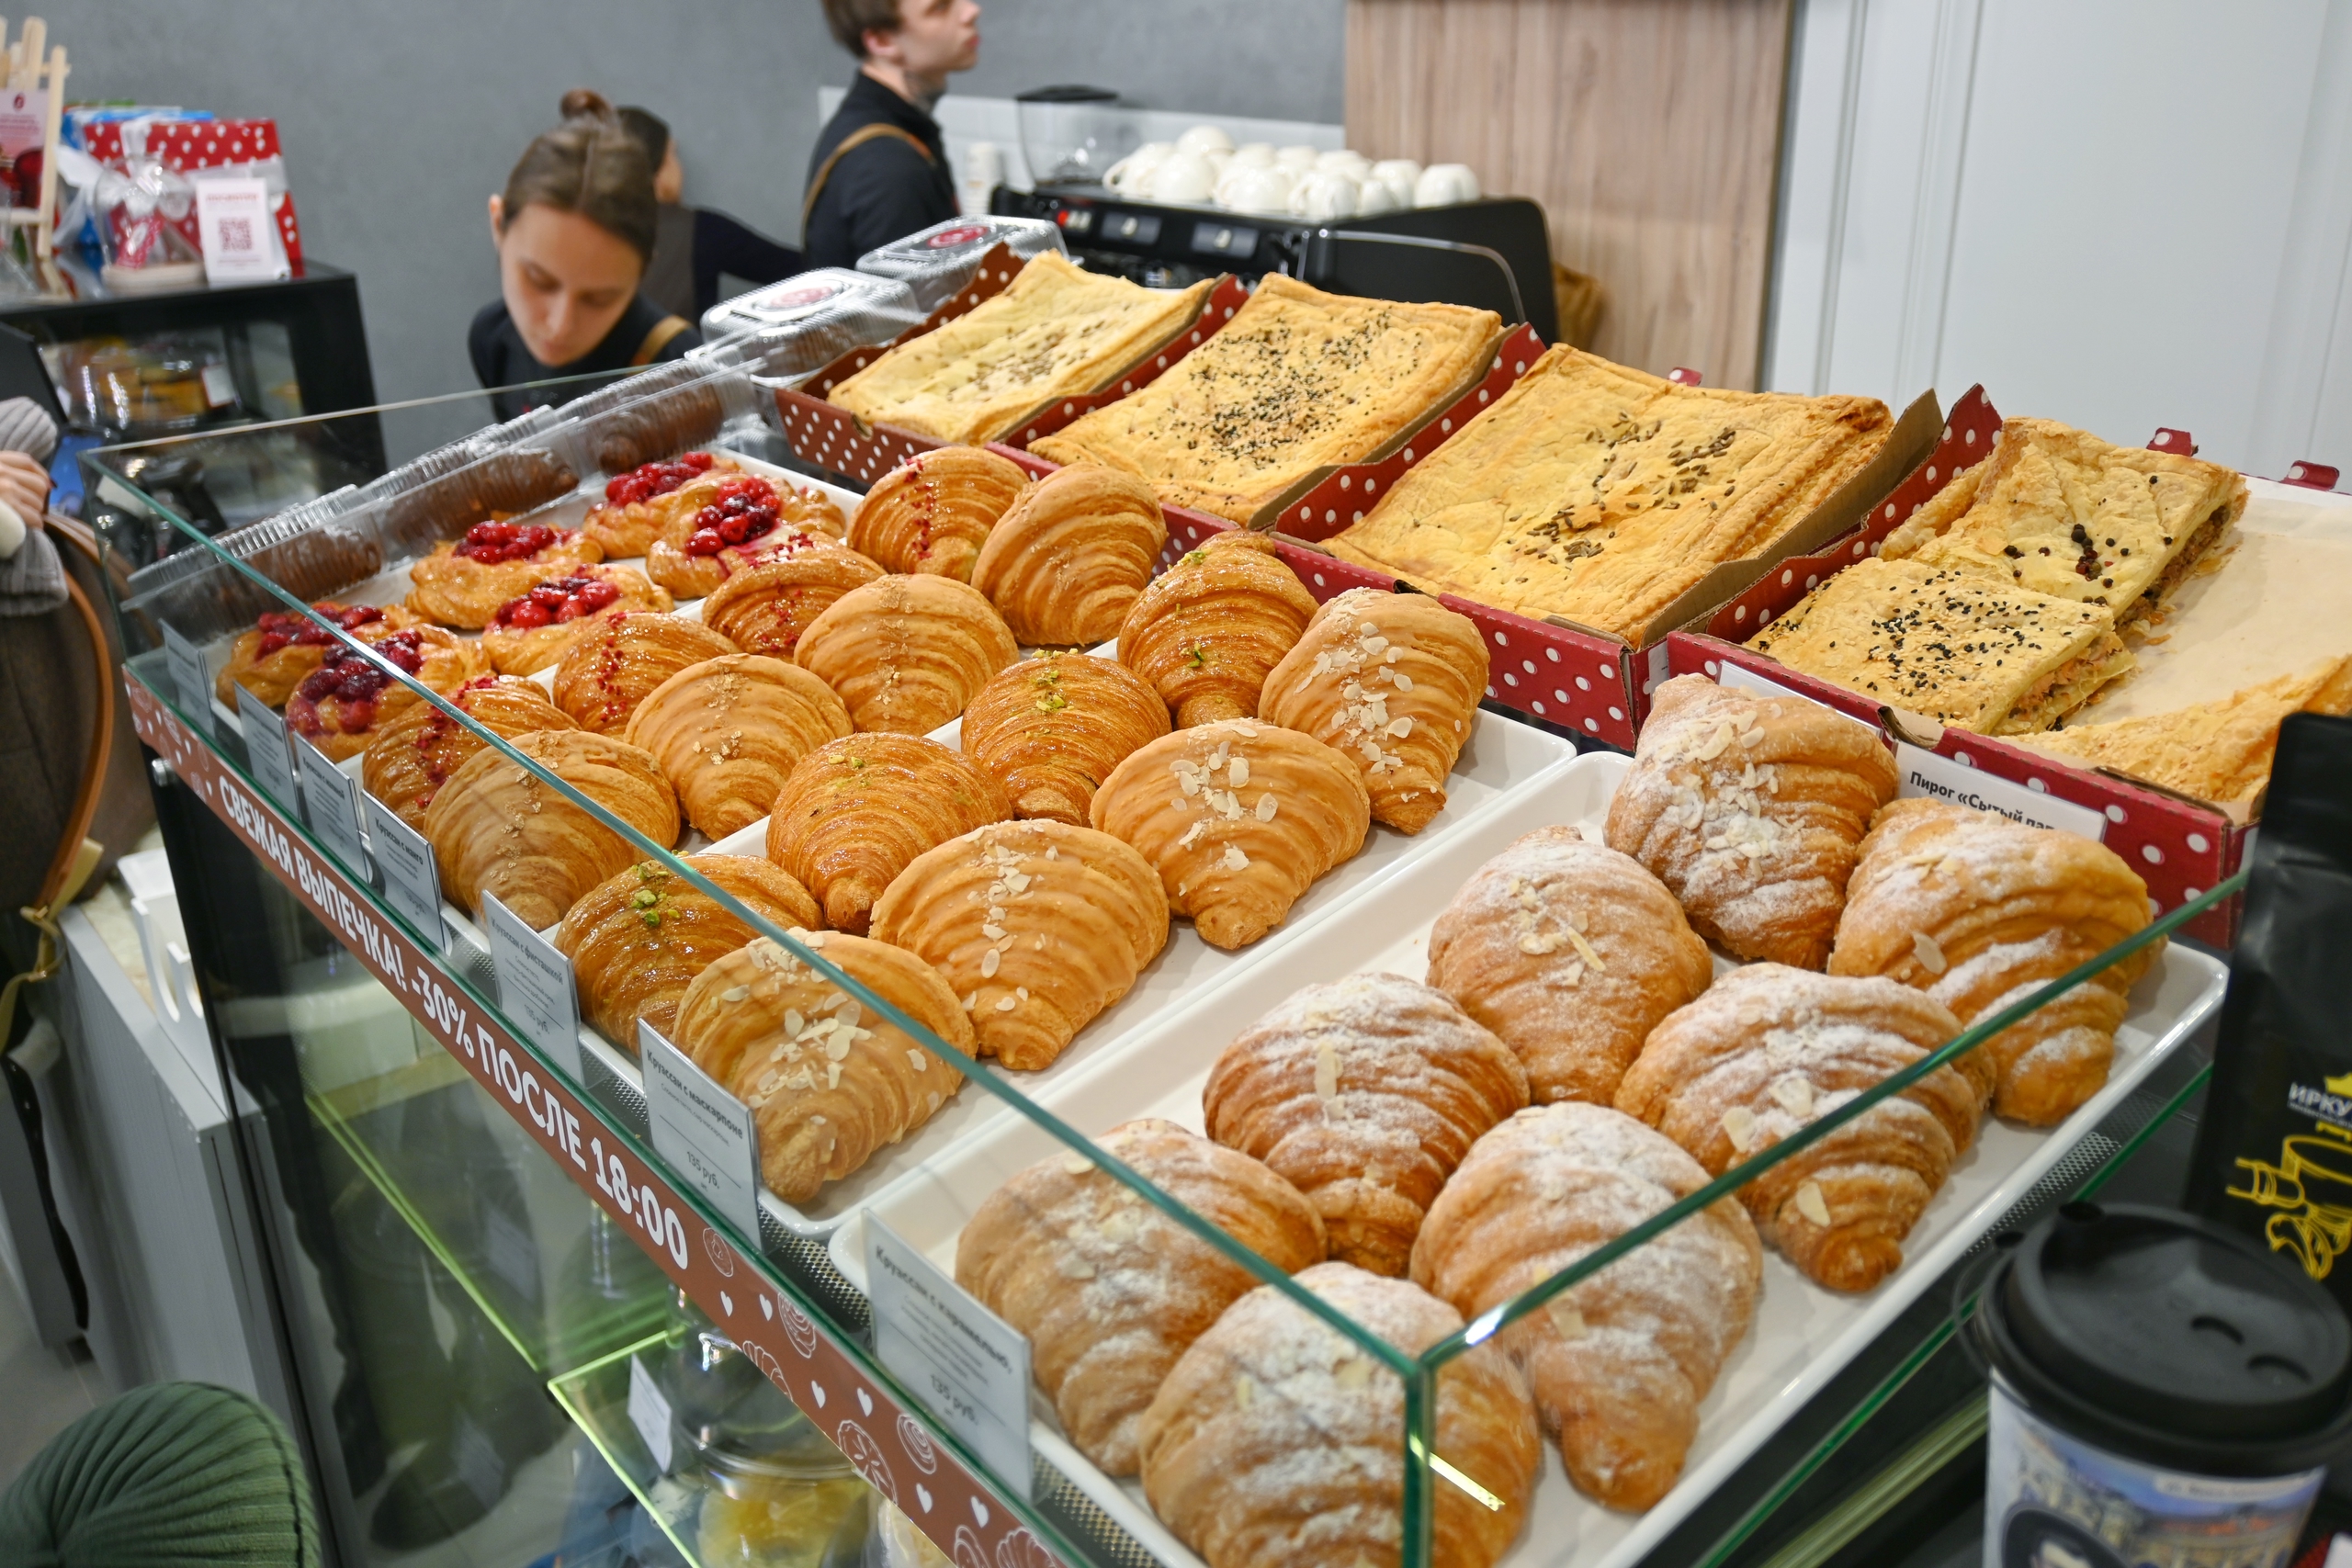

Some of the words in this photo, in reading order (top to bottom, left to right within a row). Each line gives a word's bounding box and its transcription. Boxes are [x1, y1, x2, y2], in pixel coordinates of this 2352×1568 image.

[1909, 771, 1955, 798] Пирог
[375, 817, 401, 848] Круассан
[405, 845, 424, 865] манго
[491, 916, 520, 949] Круассан
[525, 945, 564, 985] фисташкой
[219, 775, 296, 879] СВЕЖАЯ
[293, 847, 408, 992] ВЫПЕЧКА!
[411, 965, 475, 1058] -30%
[476, 1022, 587, 1172] ПОСЛЕ
[590, 1136, 688, 1269] 18:00
[647, 1048, 683, 1090] Круассан
[689, 1089, 743, 1139] маскарпоне
[686, 1151, 702, 1171] 135
[702, 1167, 720, 1190] руб.
[876, 1245, 929, 1298] Круассан
[952, 1394, 979, 1427] руб.
